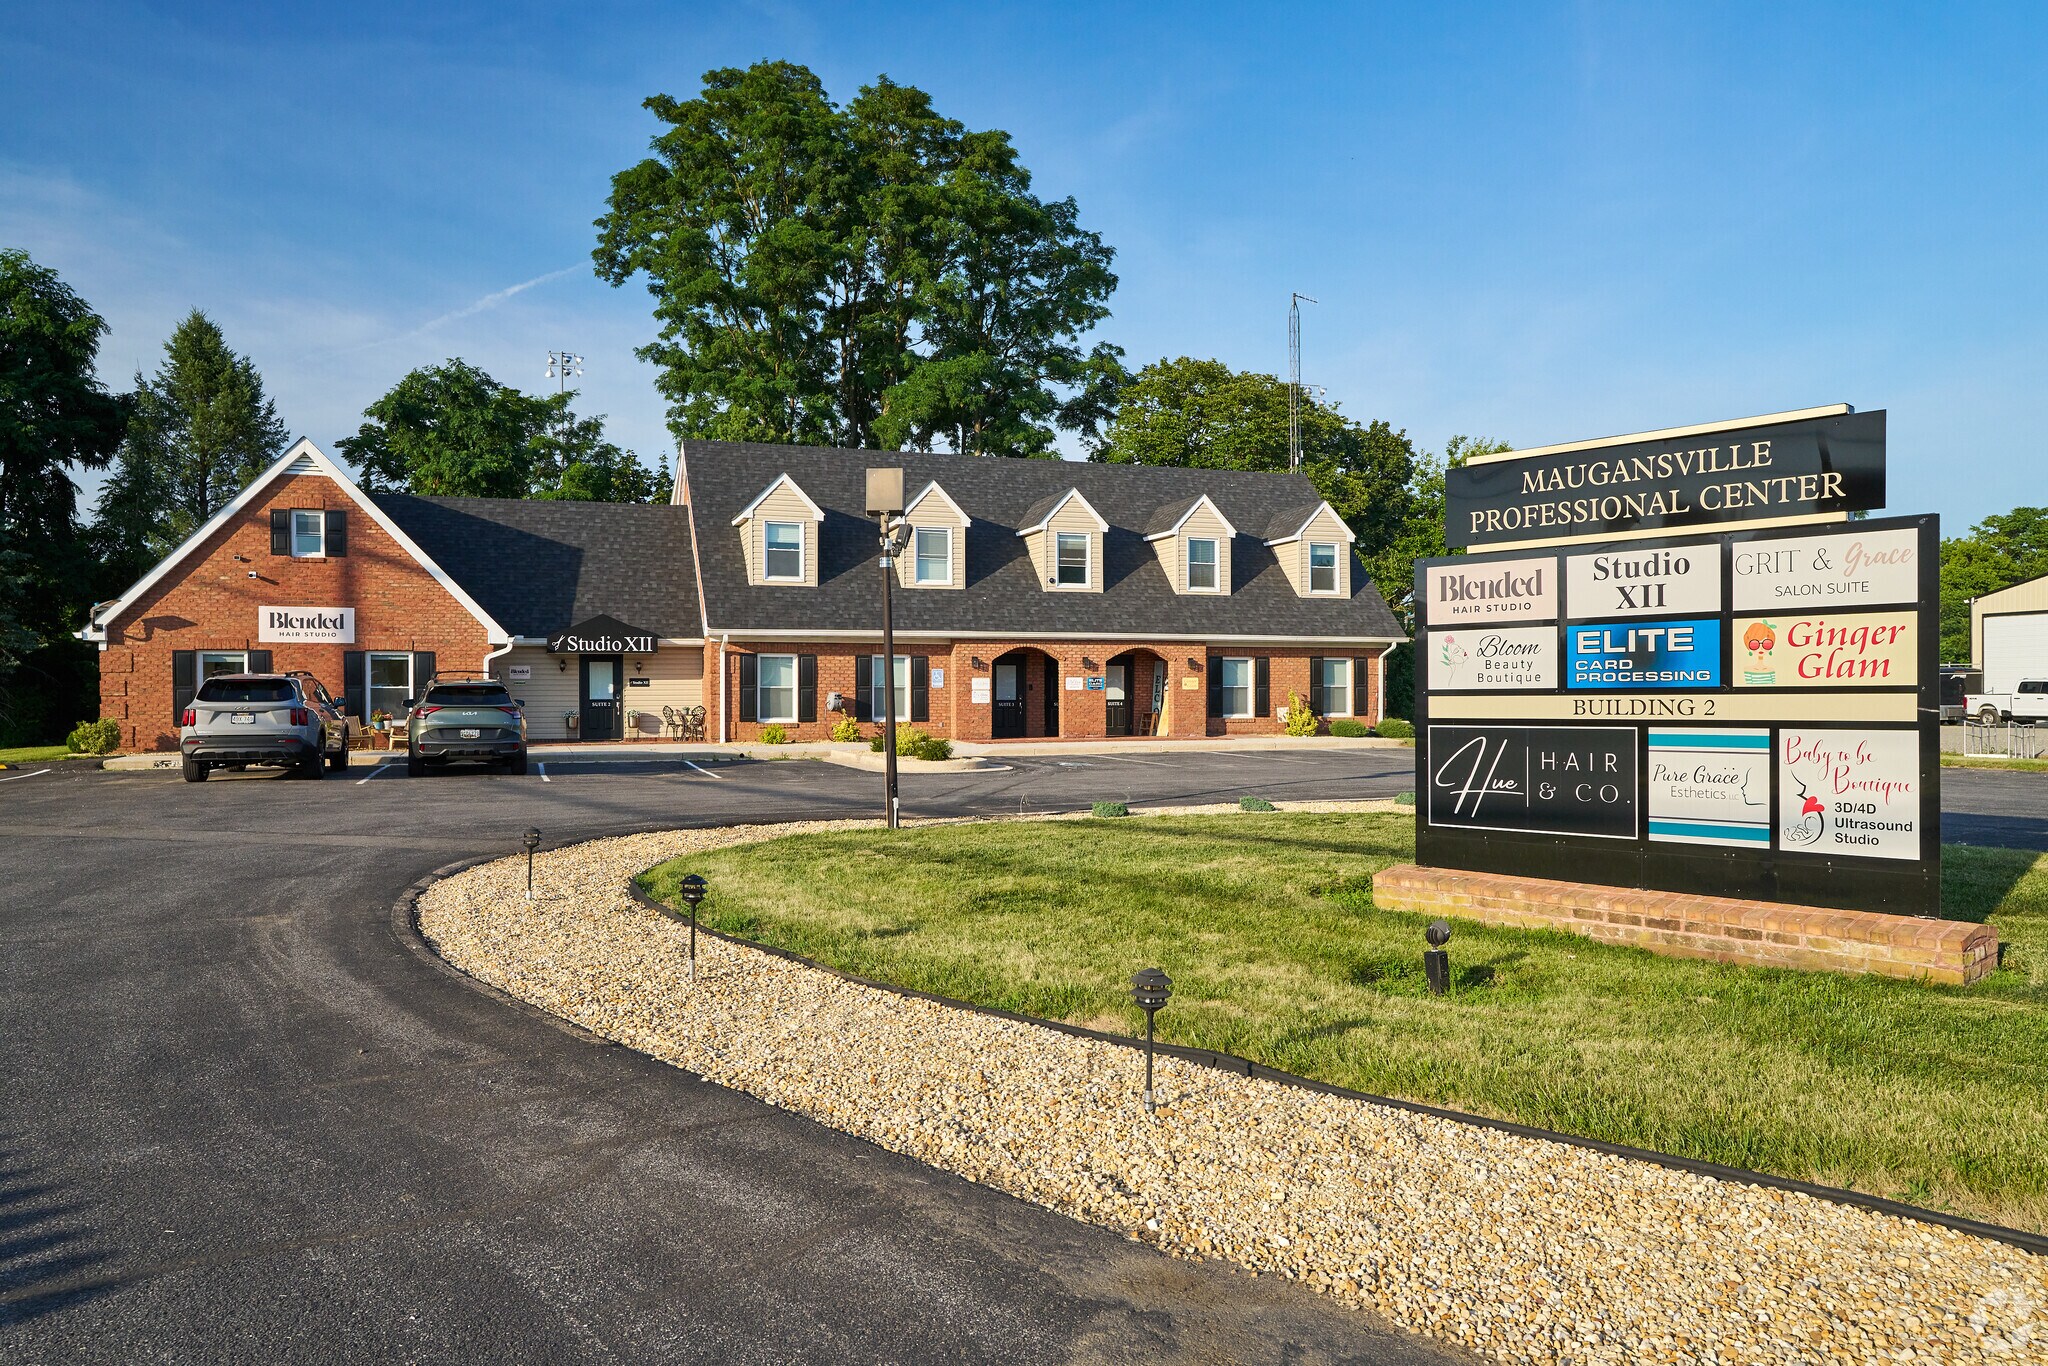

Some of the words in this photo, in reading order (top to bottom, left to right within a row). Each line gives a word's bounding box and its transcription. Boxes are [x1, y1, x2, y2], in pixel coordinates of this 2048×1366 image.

[1521, 440, 1773, 495] MAUGANSVILLE
[1470, 489, 1690, 534] PROFESSIONAL
[1699, 472, 1847, 512] CENTER
[1593, 552, 1691, 581] Studio
[1735, 550, 1801, 576] GRIT
[1812, 548, 1833, 571] &
[1843, 541, 1914, 578] Grace
[1440, 569, 1543, 603] Blended
[1615, 583, 1667, 610] XII
[1774, 583, 1822, 597] SALON
[1826, 581, 1870, 594] SUITE
[1452, 604, 1481, 614] HAIR
[1486, 602, 1532, 613] STUDIO
[269, 612, 345, 630] Blended
[567, 635, 622, 651] Studio
[624, 636, 653, 652] XII
[1477, 634, 1542, 659] Bloom
[1577, 627, 1695, 655] ELITE
[1787, 620, 1907, 654] Ginger
[1485, 659, 1534, 672] Beauty
[1575, 659, 1634, 671] CARD
[1797, 647, 1891, 679] Glam
[1477, 672, 1541, 685] Boutique
[1575, 670, 1712, 683] PROCESSING
[1573, 698, 1696, 716] BUILDING
[1704, 699, 1716, 716] 2
[1541, 751, 1618, 773] HAIR
[1784, 735, 1832, 781] Baby
[1836, 749, 1852, 763] to
[1854, 739, 1877, 764] be
[1435, 736, 1525, 818] Hue
[1653, 763, 1688, 783] Pure
[1693, 765, 1740, 785] Grace
[1539, 782, 1557, 800] &
[1575, 783, 1631, 804] CO.
[1670, 785, 1727, 800] Esthetics
[1831, 765, 1917, 806] Boutique
[1834, 802, 1877, 815] 3D/4D
[1834, 817, 1913, 832] Ultrasound
[1834, 833, 1880, 846] Studio
